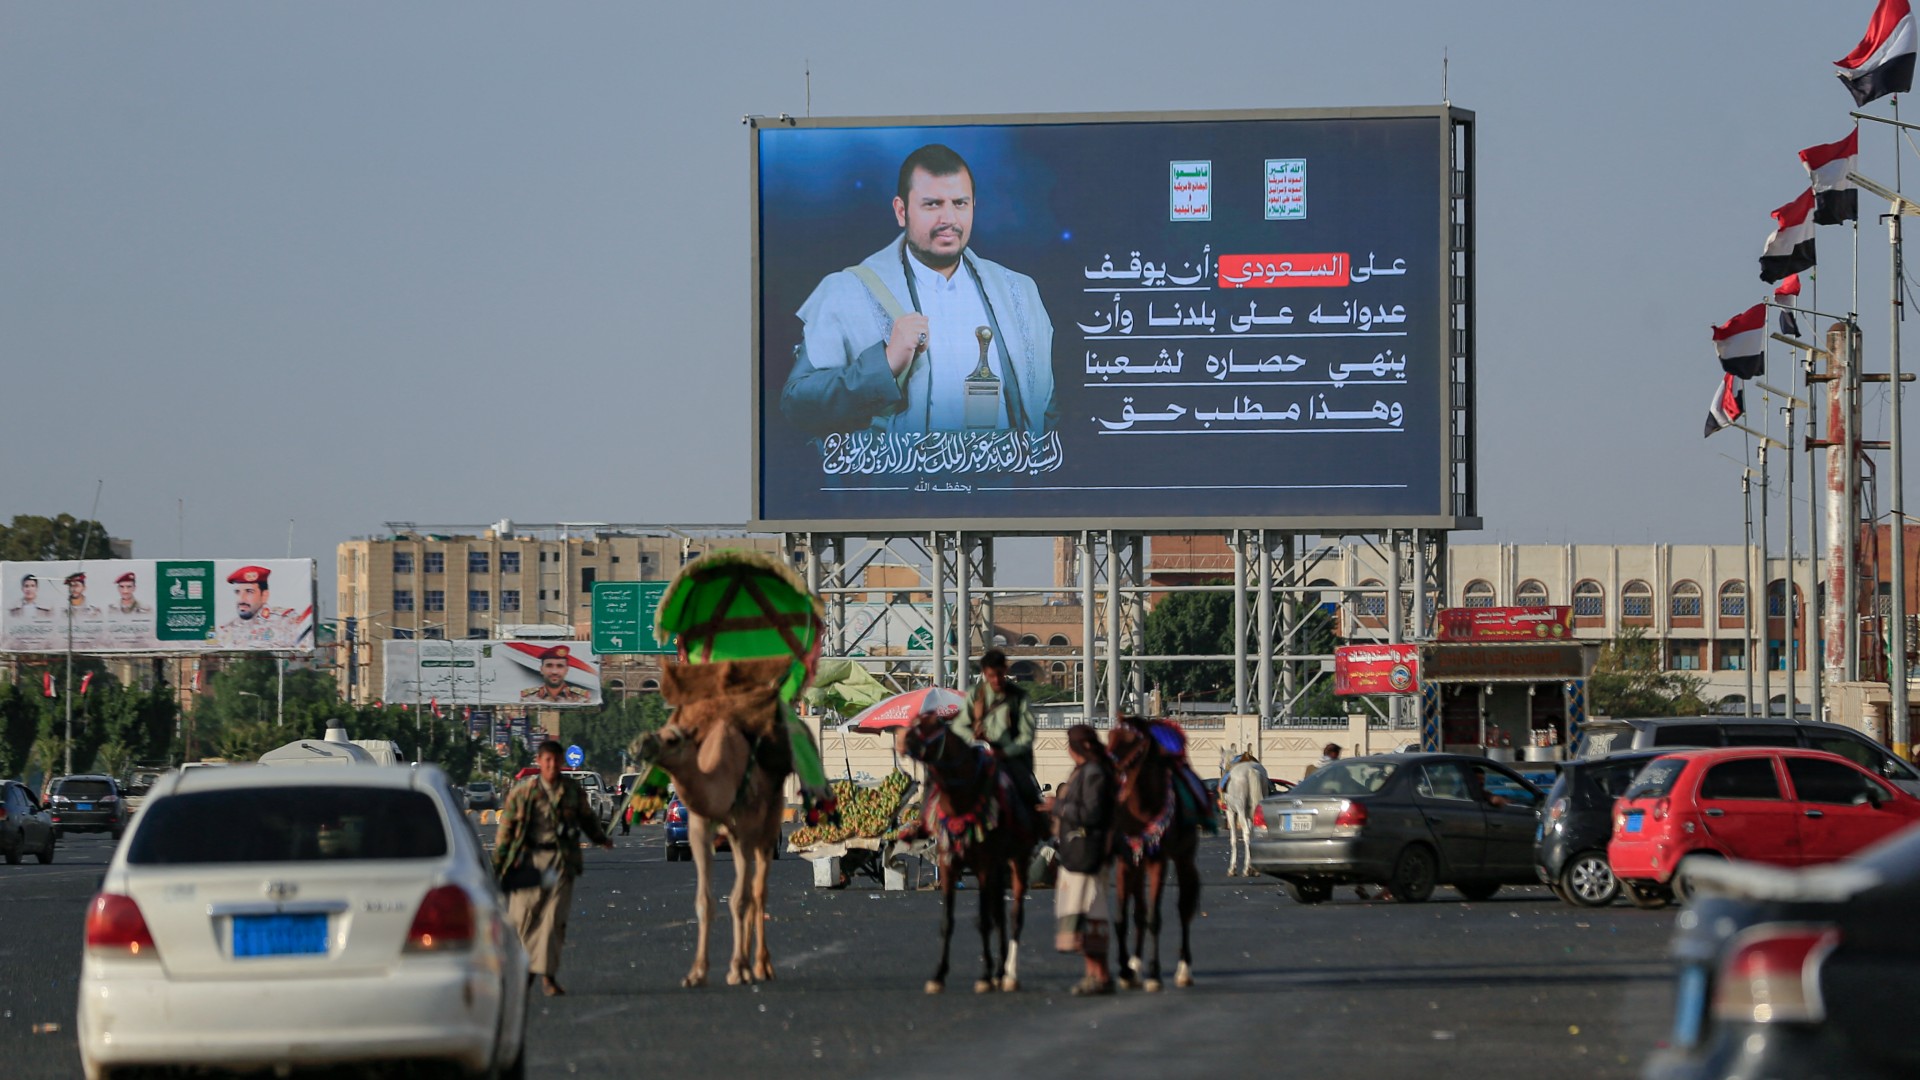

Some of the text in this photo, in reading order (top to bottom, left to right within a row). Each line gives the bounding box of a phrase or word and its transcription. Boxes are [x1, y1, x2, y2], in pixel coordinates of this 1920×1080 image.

[1085, 251, 1167, 286] يوقف
[1166, 244, 1211, 284] أن
[1350, 252, 1406, 283] على
[1077, 293, 1407, 334] عدوانه على بلدنا وأن
[1085, 349, 1406, 388] ينهي حصاره لشعبنا
[1195, 396, 1301, 428] مطلب
[1310, 393, 1404, 426] وهذا
[914, 477, 972, 494] يحفظه الله
